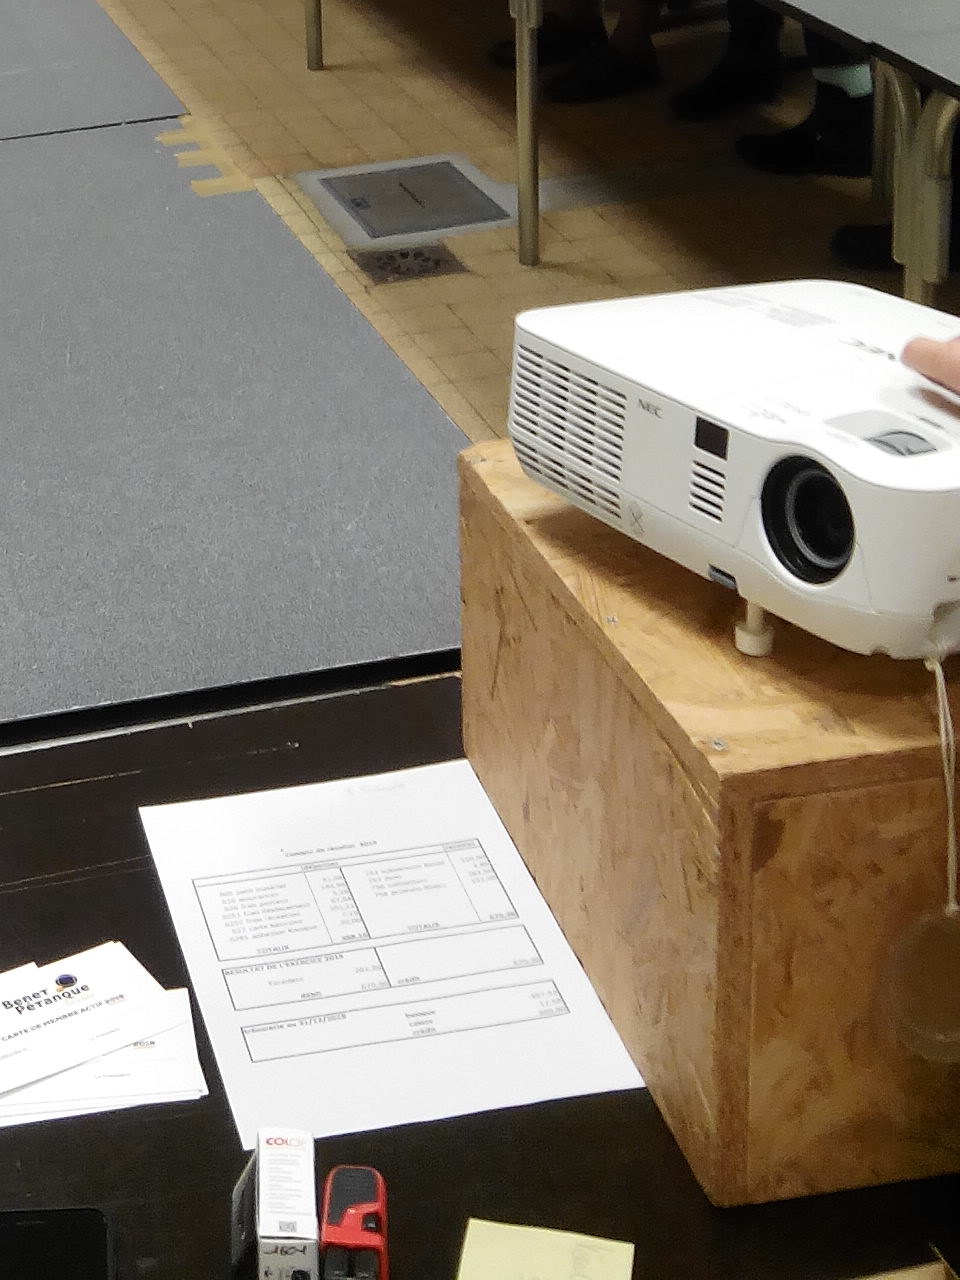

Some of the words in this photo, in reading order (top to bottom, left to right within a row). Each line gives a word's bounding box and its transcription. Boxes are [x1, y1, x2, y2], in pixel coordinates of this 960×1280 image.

[638, 397, 663, 419] NEC
[1, 1028, 29, 1042] CARTE
[30, 1023, 42, 1032] DE
[43, 1010, 80, 1027] MEMBRE
